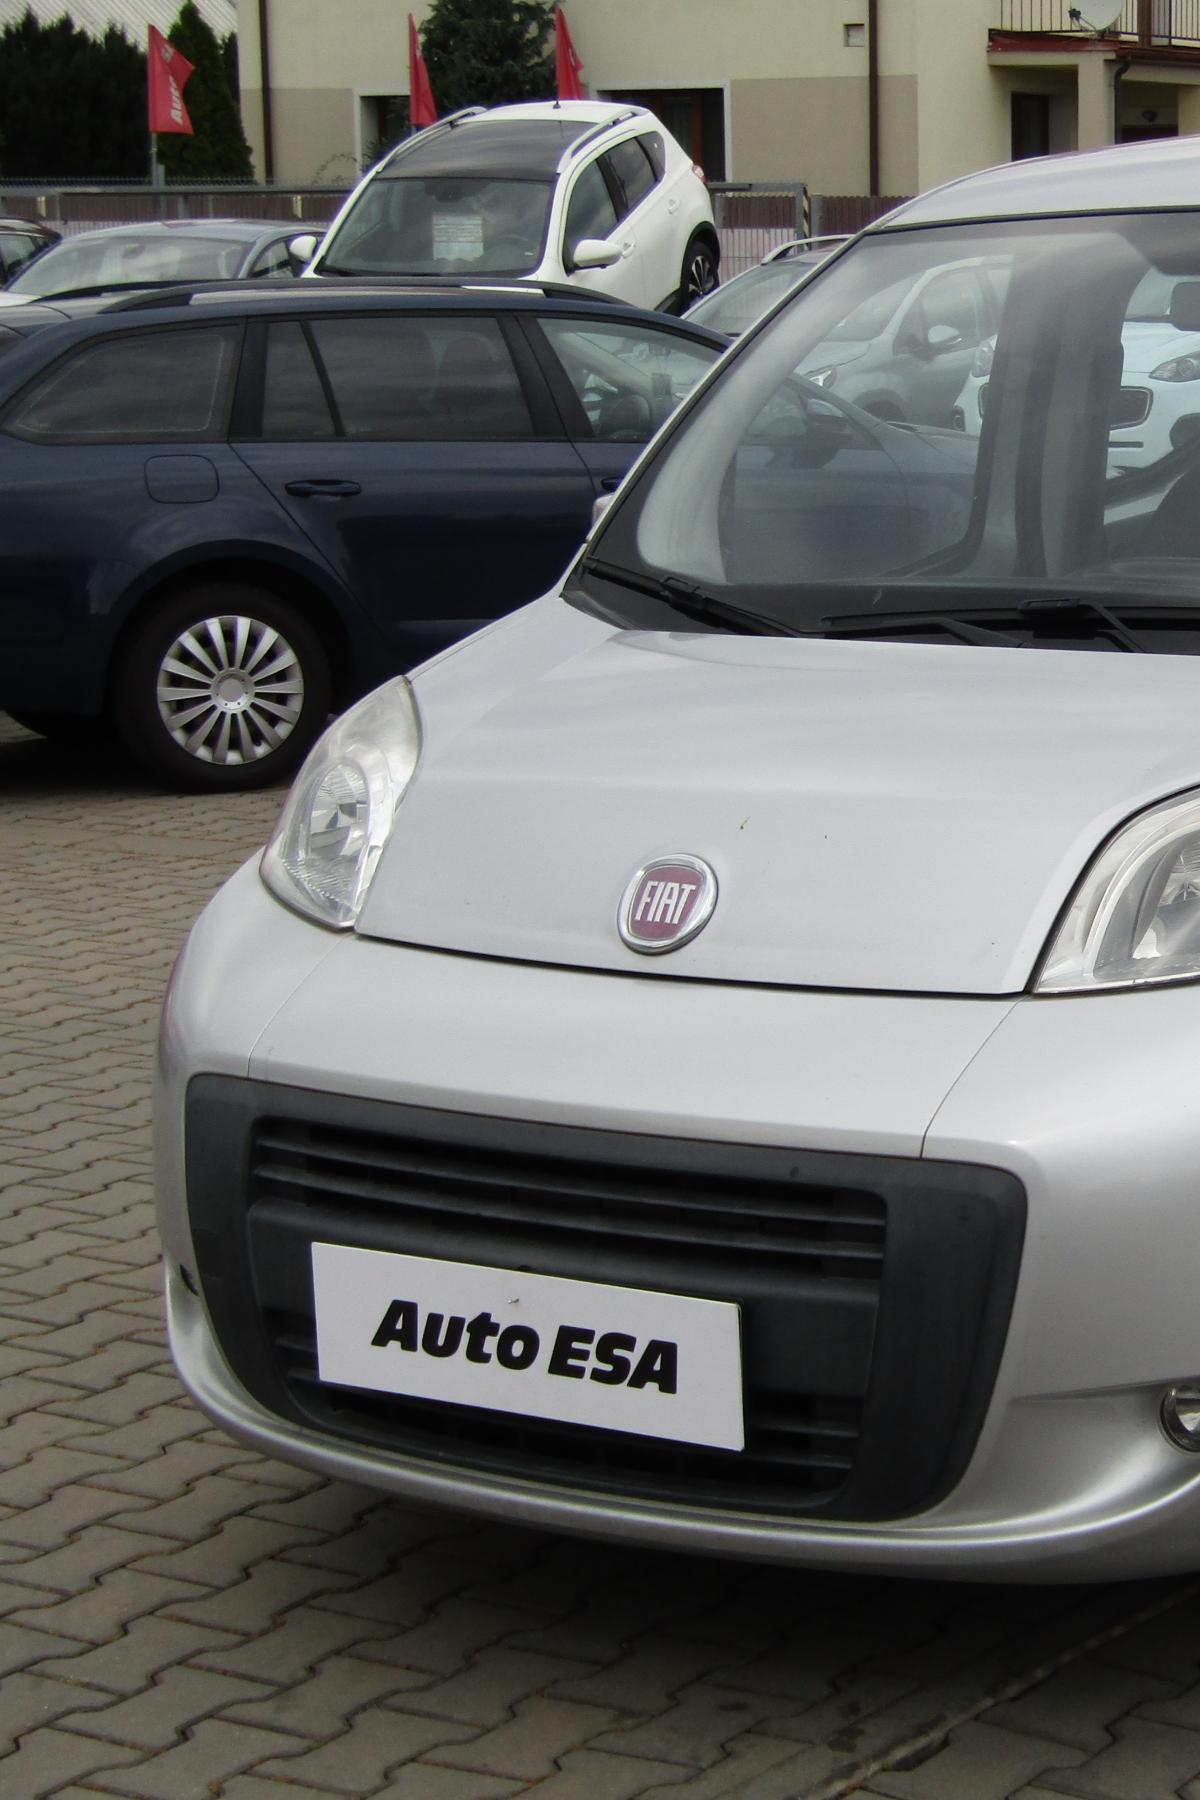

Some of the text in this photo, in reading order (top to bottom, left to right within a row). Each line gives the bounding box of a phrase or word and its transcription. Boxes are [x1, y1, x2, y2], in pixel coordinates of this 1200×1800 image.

[635, 880, 697, 925] FIAT
[371, 1300, 678, 1395] Auto ESA
